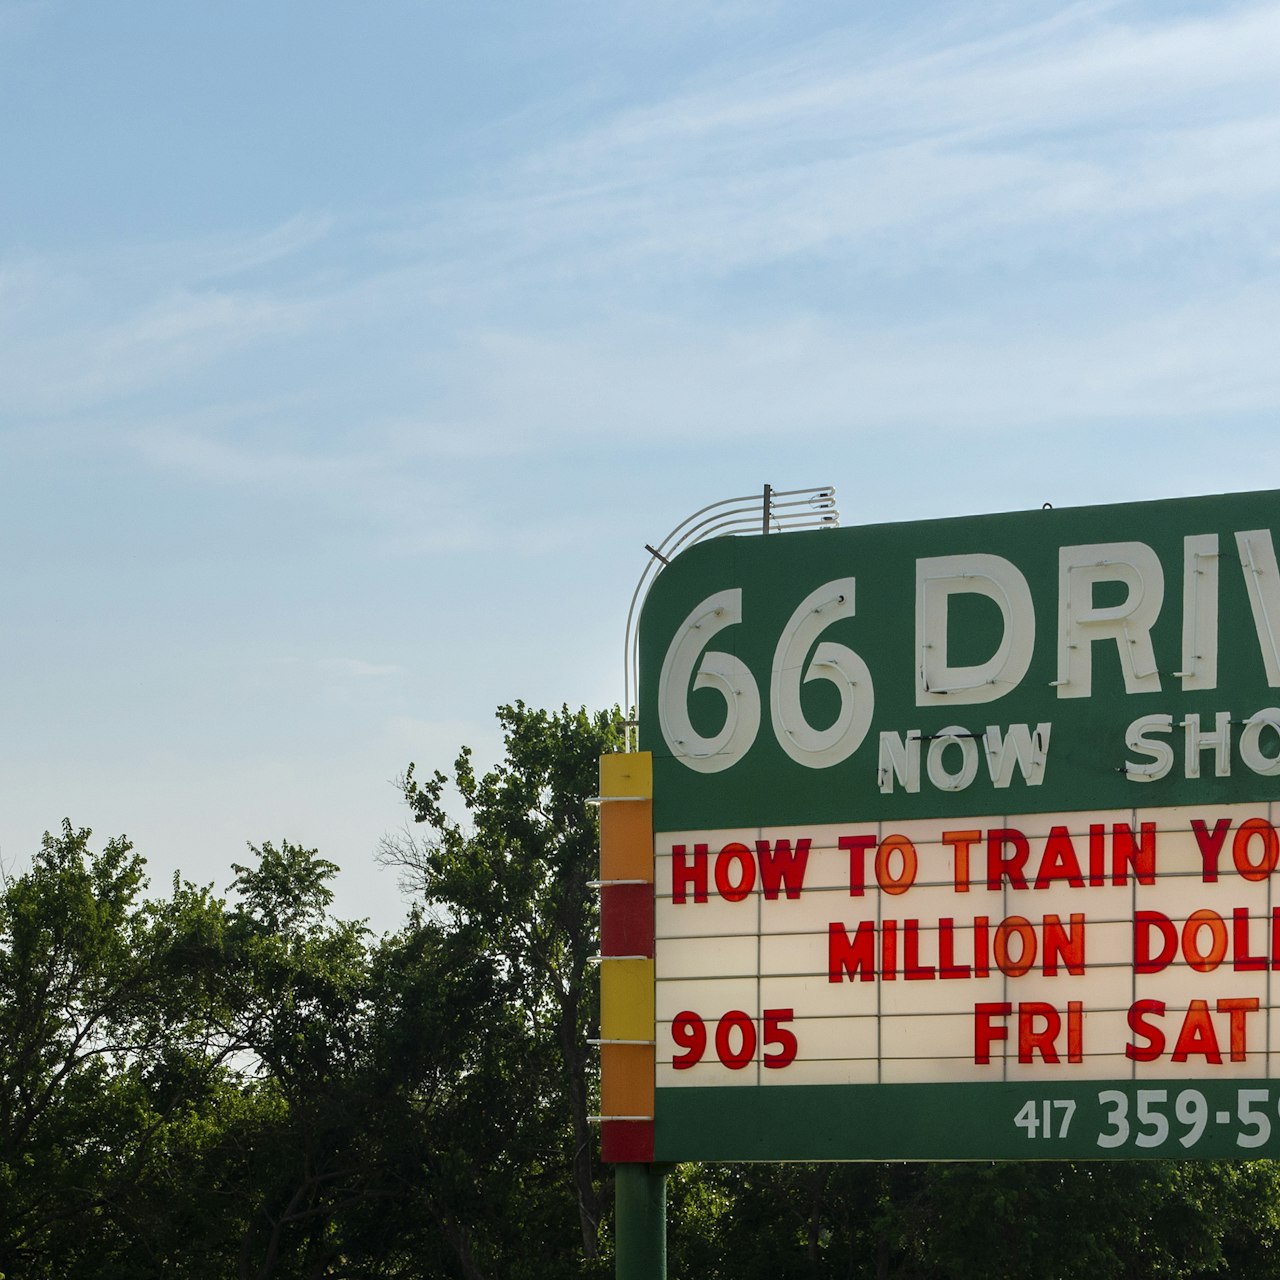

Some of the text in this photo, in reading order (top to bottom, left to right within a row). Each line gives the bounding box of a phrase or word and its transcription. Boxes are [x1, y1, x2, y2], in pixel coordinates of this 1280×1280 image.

[659, 577, 875, 773] 66
[878, 722, 1052, 794] NOW
[671, 838, 812, 904] HOW
[838, 834, 918, 897] TO
[942, 821, 1157, 893] TRAIN
[828, 912, 1086, 983] MILLION
[671, 1008, 798, 1070] 905
[973, 1001, 1083, 1066] FRI
[1125, 997, 1260, 1065] SAT
[1013, 1099, 1077, 1140] 417
